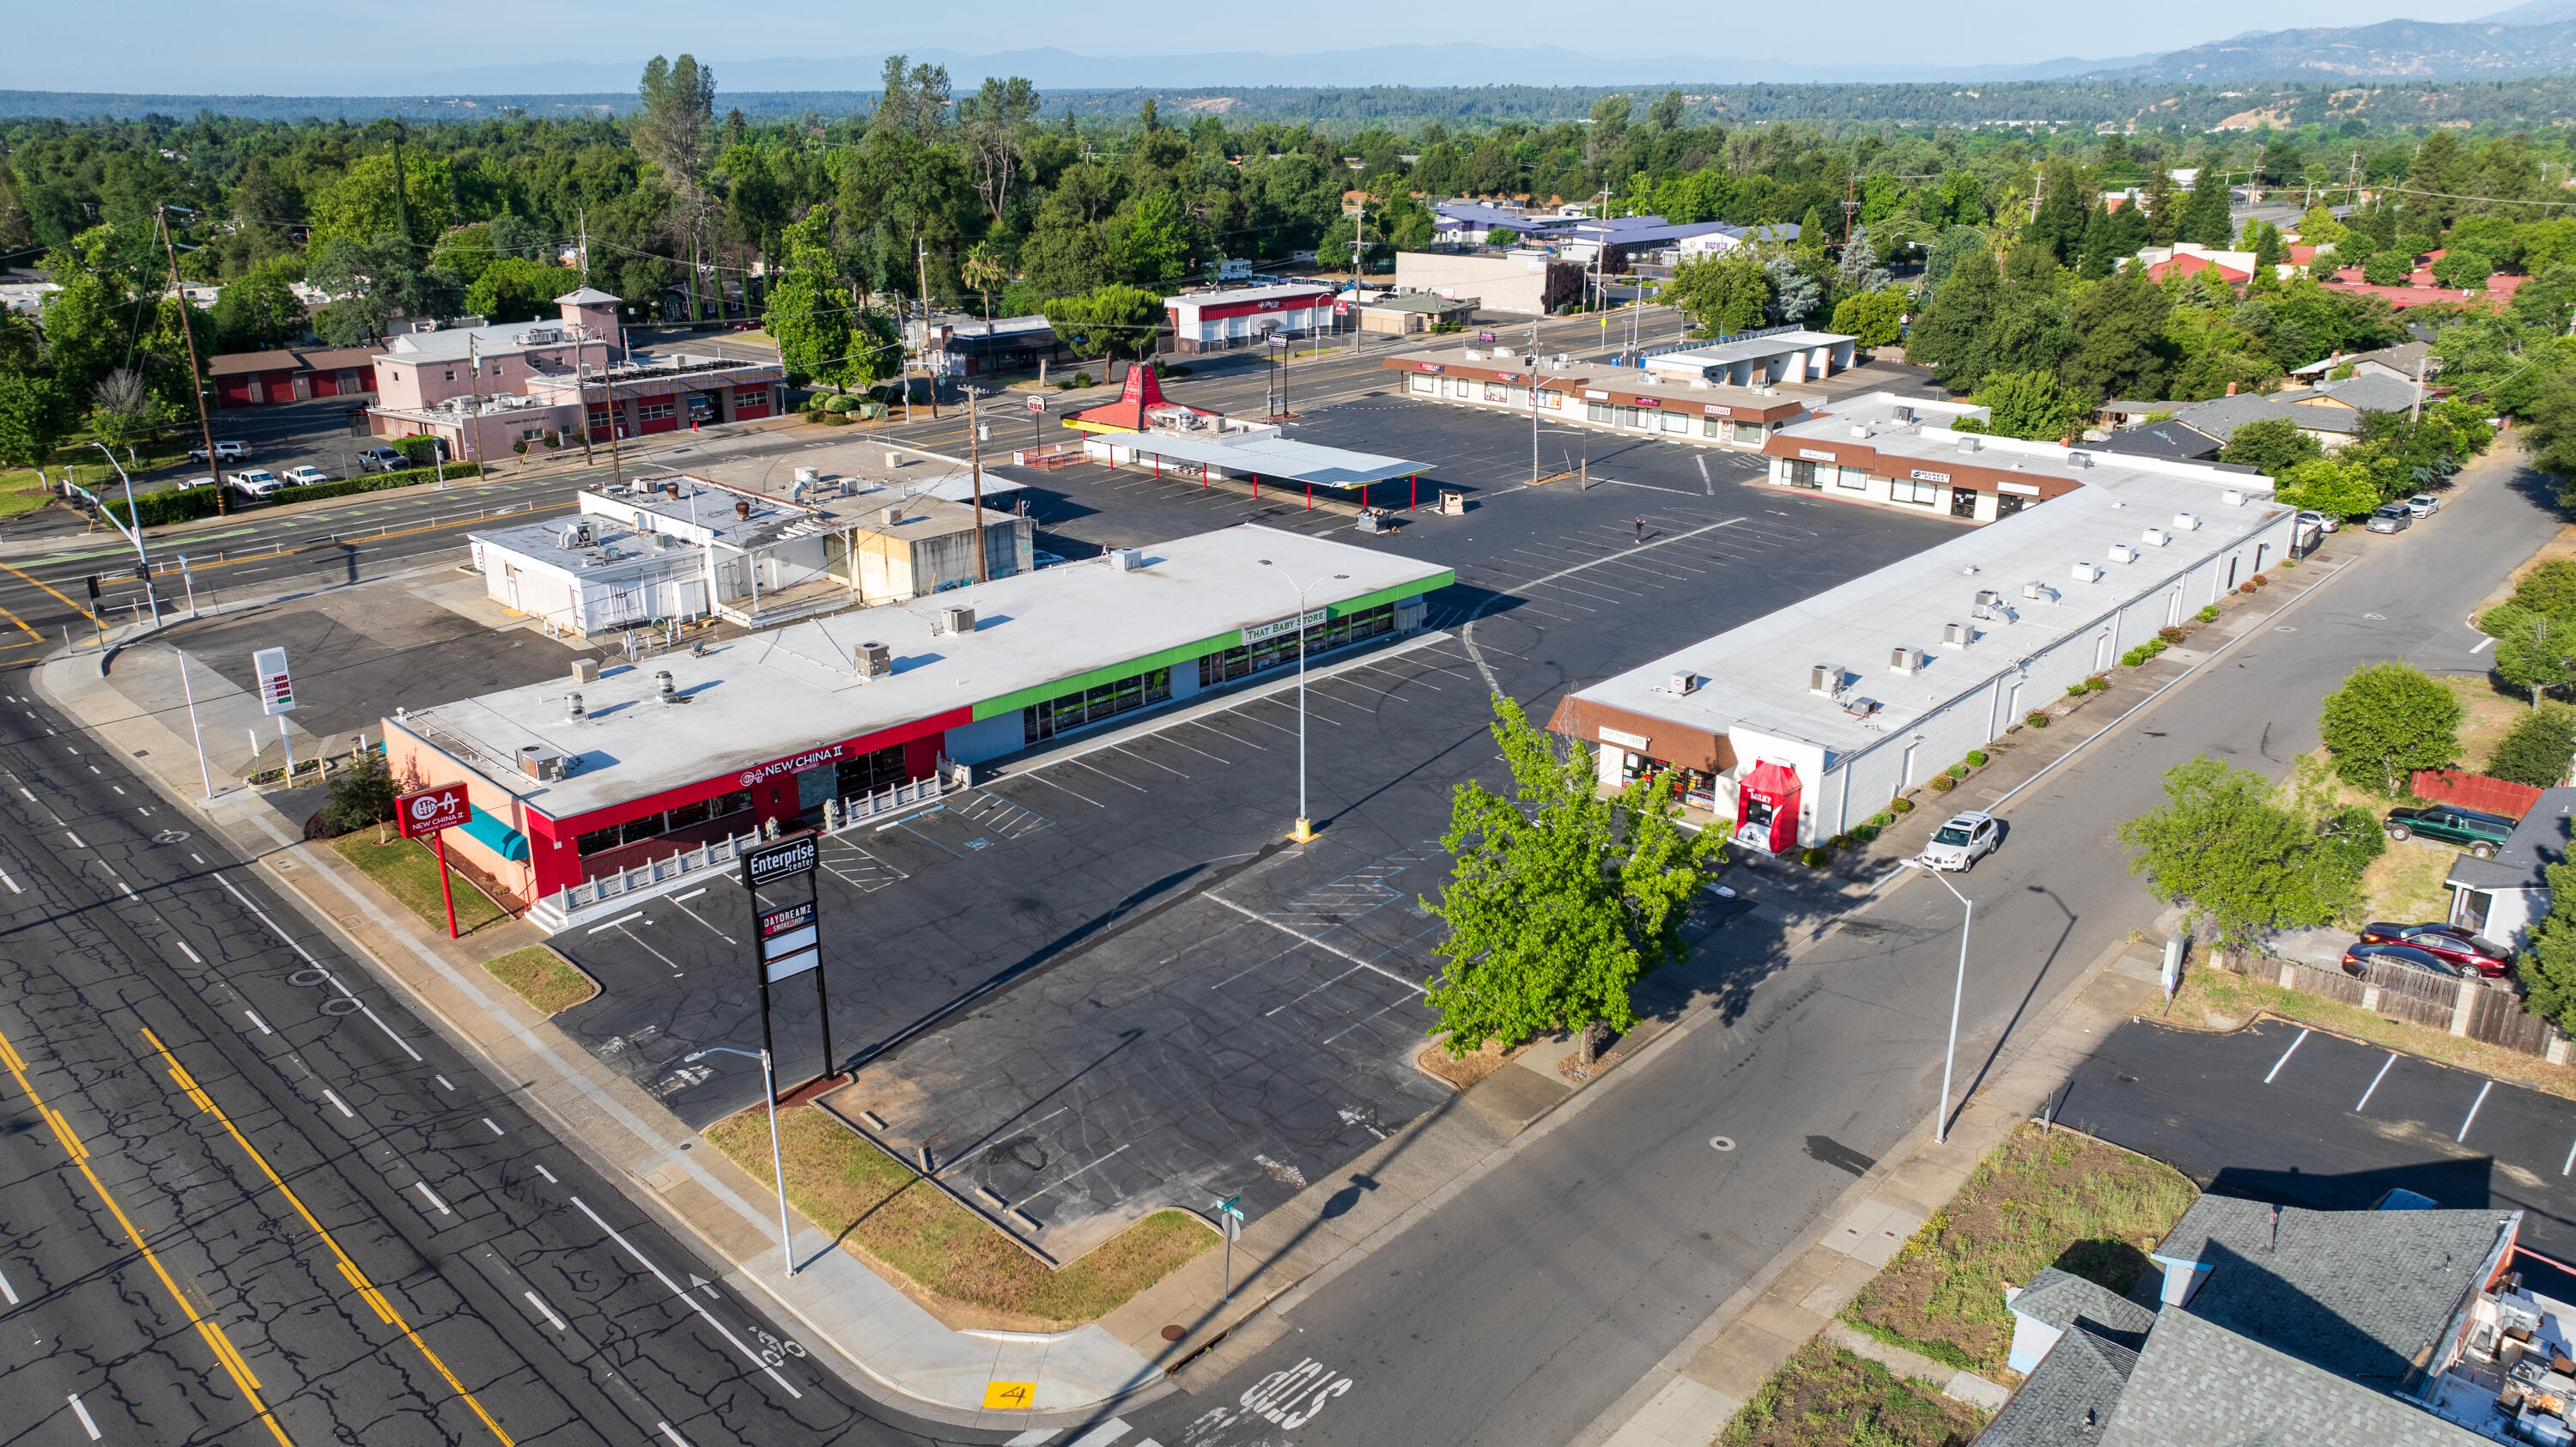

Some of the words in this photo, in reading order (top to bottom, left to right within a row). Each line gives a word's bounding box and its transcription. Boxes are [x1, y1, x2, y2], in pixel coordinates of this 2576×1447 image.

[1706, 406, 1729, 415] MASSAGE
[1248, 627, 1270, 640] THAT
[1273, 621, 1295, 633] BABY
[1297, 611, 1324, 626] STORE
[765, 759, 793, 776] NEW
[795, 749, 832, 767] CHINA
[1751, 792, 1771, 803] MILK?
[412, 820, 431, 830] NEW
[432, 814, 457, 825] CHINA
[750, 844, 815, 875] Enterprise
[789, 859, 814, 872] center
[763, 904, 811, 927] DAYDREAMZ
[773, 921, 791, 932] SMOKE
[791, 915, 805, 927] SHOP
